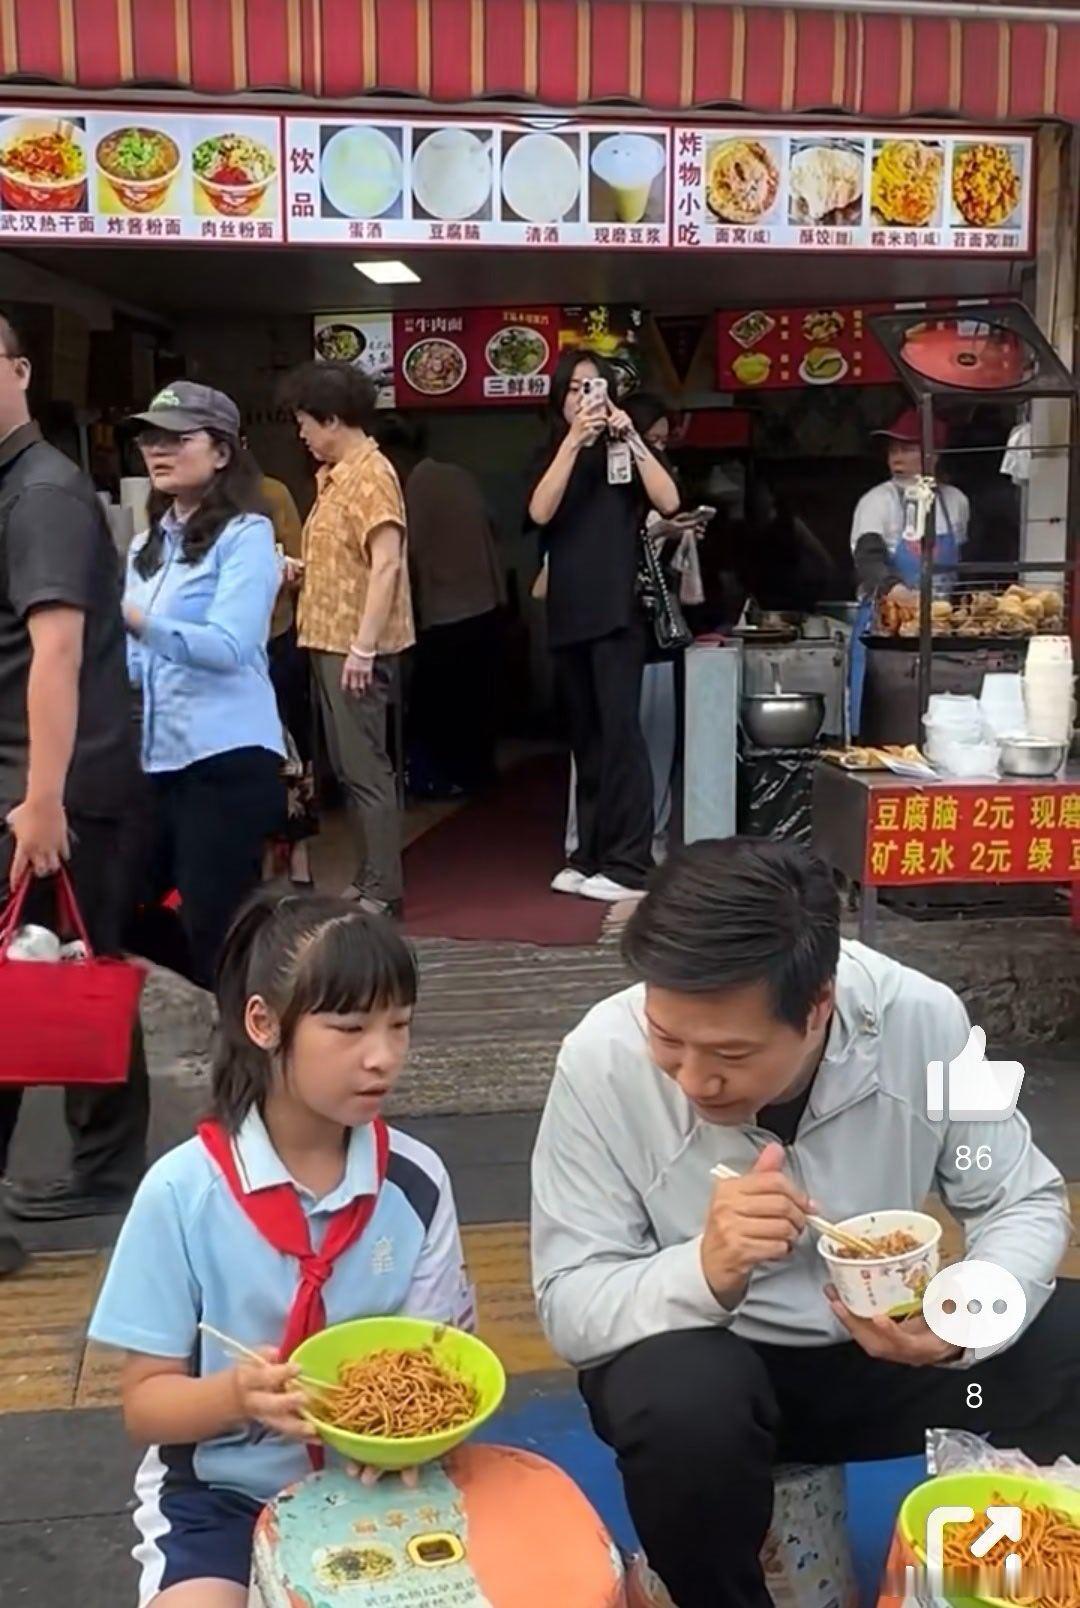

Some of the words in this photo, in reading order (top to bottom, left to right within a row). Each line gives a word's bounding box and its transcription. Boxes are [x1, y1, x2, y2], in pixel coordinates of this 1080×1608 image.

[290, 148, 315, 217] 饮品
[679, 131, 701, 247] 炸物小吃
[1, 214, 95, 233] 武汉热干面
[107, 217, 181, 235] 炸酱粉面
[201, 220, 274, 238] 肉丝粉面
[348, 223, 382, 239] 蛋酒
[525, 226, 559, 243] 清酒
[594, 227, 661, 244] 现磨豆浆
[488, 378, 545, 395] 三鲜粉
[874, 795, 959, 831] 豆腐脑
[973, 796, 1015, 829] 2元
[871, 838, 955, 875] 矿泉水
[970, 839, 1012, 873] 2元
